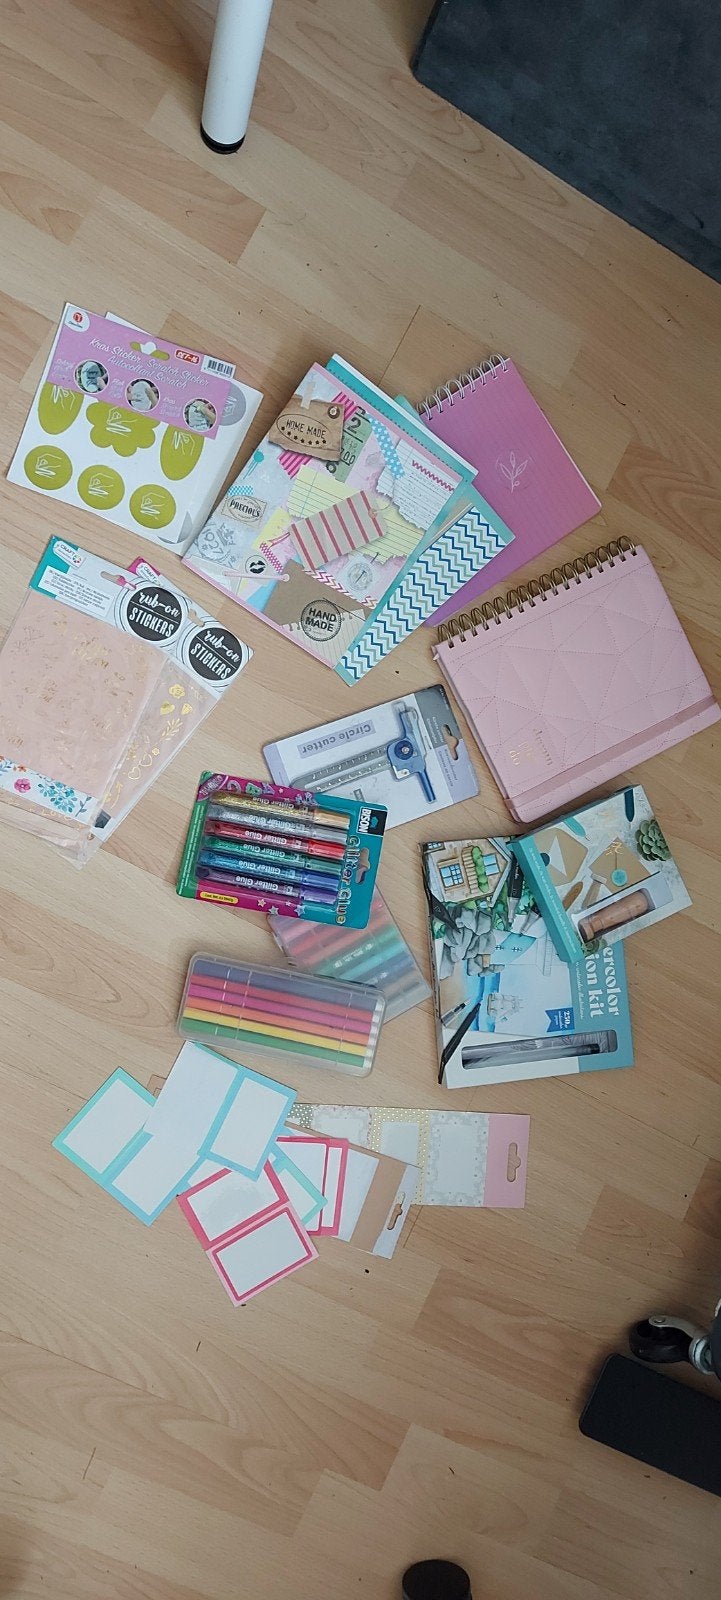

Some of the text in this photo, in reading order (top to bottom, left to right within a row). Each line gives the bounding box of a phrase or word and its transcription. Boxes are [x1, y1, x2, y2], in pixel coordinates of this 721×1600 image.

[147, 358, 180, 376] Scratch
[180, 370, 209, 387] Sticker
[154, 373, 187, 389] Scratch
[286, 418, 327, 440] HOME MADE
[347, 416, 361, 434] 2
[59, 543, 76, 558] CRAFT
[138, 590, 181, 618] rub-on
[308, 607, 337, 623] HAND
[129, 606, 175, 638] STICKERS
[305, 616, 335, 633] MADE
[204, 629, 241, 664] rub-on
[190, 642, 231, 680] STICKERS
[301, 723, 372, 755] Circle cutter
[358, 809, 371, 833] BISON
[245, 830, 287, 844] Glitter Glue
[243, 843, 285, 858] Glitter Glue
[238, 860, 281, 875] Glitter Glue
[235, 875, 278, 891] Glitter Glue
[336, 835, 361, 925] Glitter Glue
[588, 989, 605, 1018] kit
